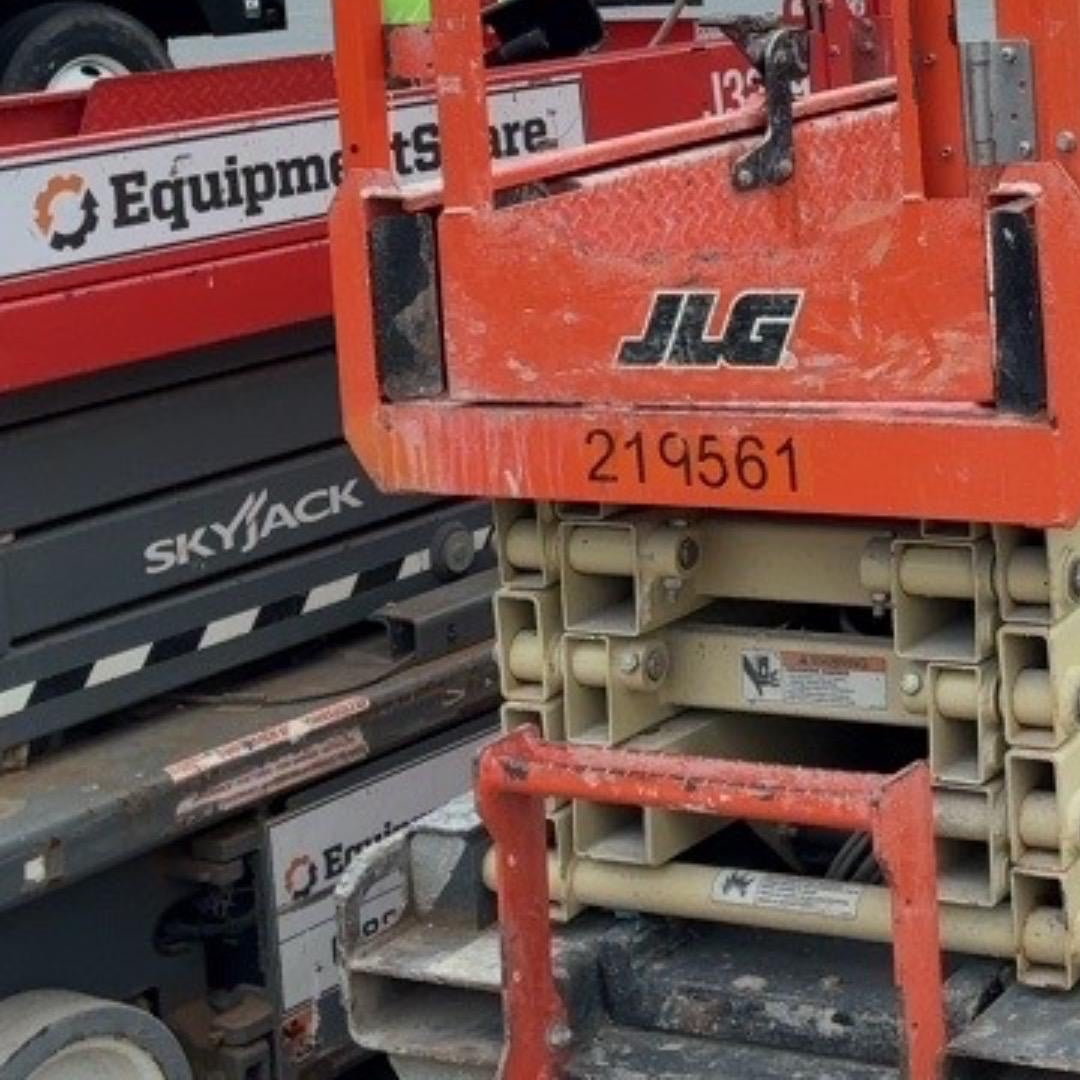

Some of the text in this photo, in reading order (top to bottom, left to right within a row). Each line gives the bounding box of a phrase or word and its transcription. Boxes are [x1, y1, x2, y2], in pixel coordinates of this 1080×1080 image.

[109, 116, 548, 232] EquipmtSre
[614, 288, 805, 370] JLG
[584, 428, 799, 493] 219561
[144, 478, 364, 574] SKYJACK
